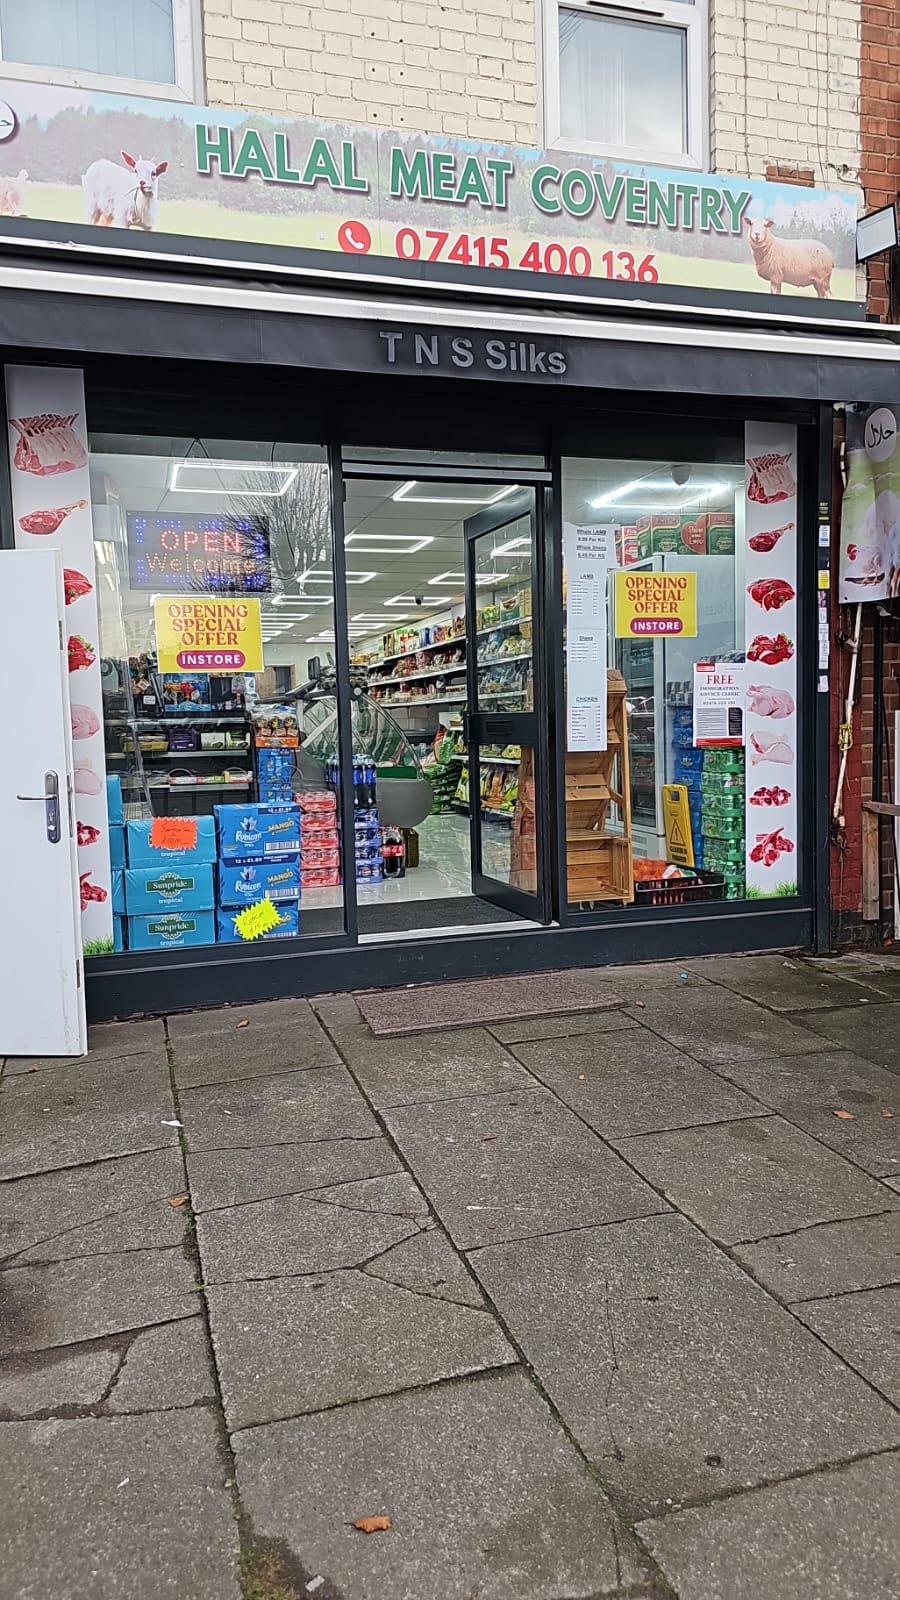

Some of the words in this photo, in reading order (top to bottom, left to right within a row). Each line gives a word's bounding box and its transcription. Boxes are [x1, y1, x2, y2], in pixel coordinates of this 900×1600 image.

[195, 122, 368, 193] HALAL
[389, 147, 513, 208] MEAT
[531, 163, 751, 234] COVENTRY
[395, 227, 509, 268] 07415
[519, 241, 592, 277] 400
[602, 249, 659, 284] 136
[379, 331, 402, 363] T
[415, 335, 438, 365] N
[451, 337, 474, 368] S
[486, 339, 567, 375] Silks
[160, 530, 241, 553] OPEN
[145, 552, 256, 574] Welcome
[625, 577, 687, 589] OPENING
[628, 589, 685, 601] SPECIAL
[168, 604, 248, 618] OPENING
[634, 602, 679, 614] OFFER
[172, 618, 246, 632] SPECIAL
[634, 622, 680, 631] INSTORE
[181, 632, 239, 646] OFFER
[181, 654, 241, 665] INSTORE
[707, 674, 734, 685] FREE
[267, 820, 295, 832] MANGO
[235, 830, 262, 843] Rubicon
[267, 871, 294, 883] MANGO
[152, 881, 187, 890] Sunpride
[235, 880, 262, 893] Rubicon
[158, 897, 184, 905] tropical
[154, 922, 189, 932] Sunpride
